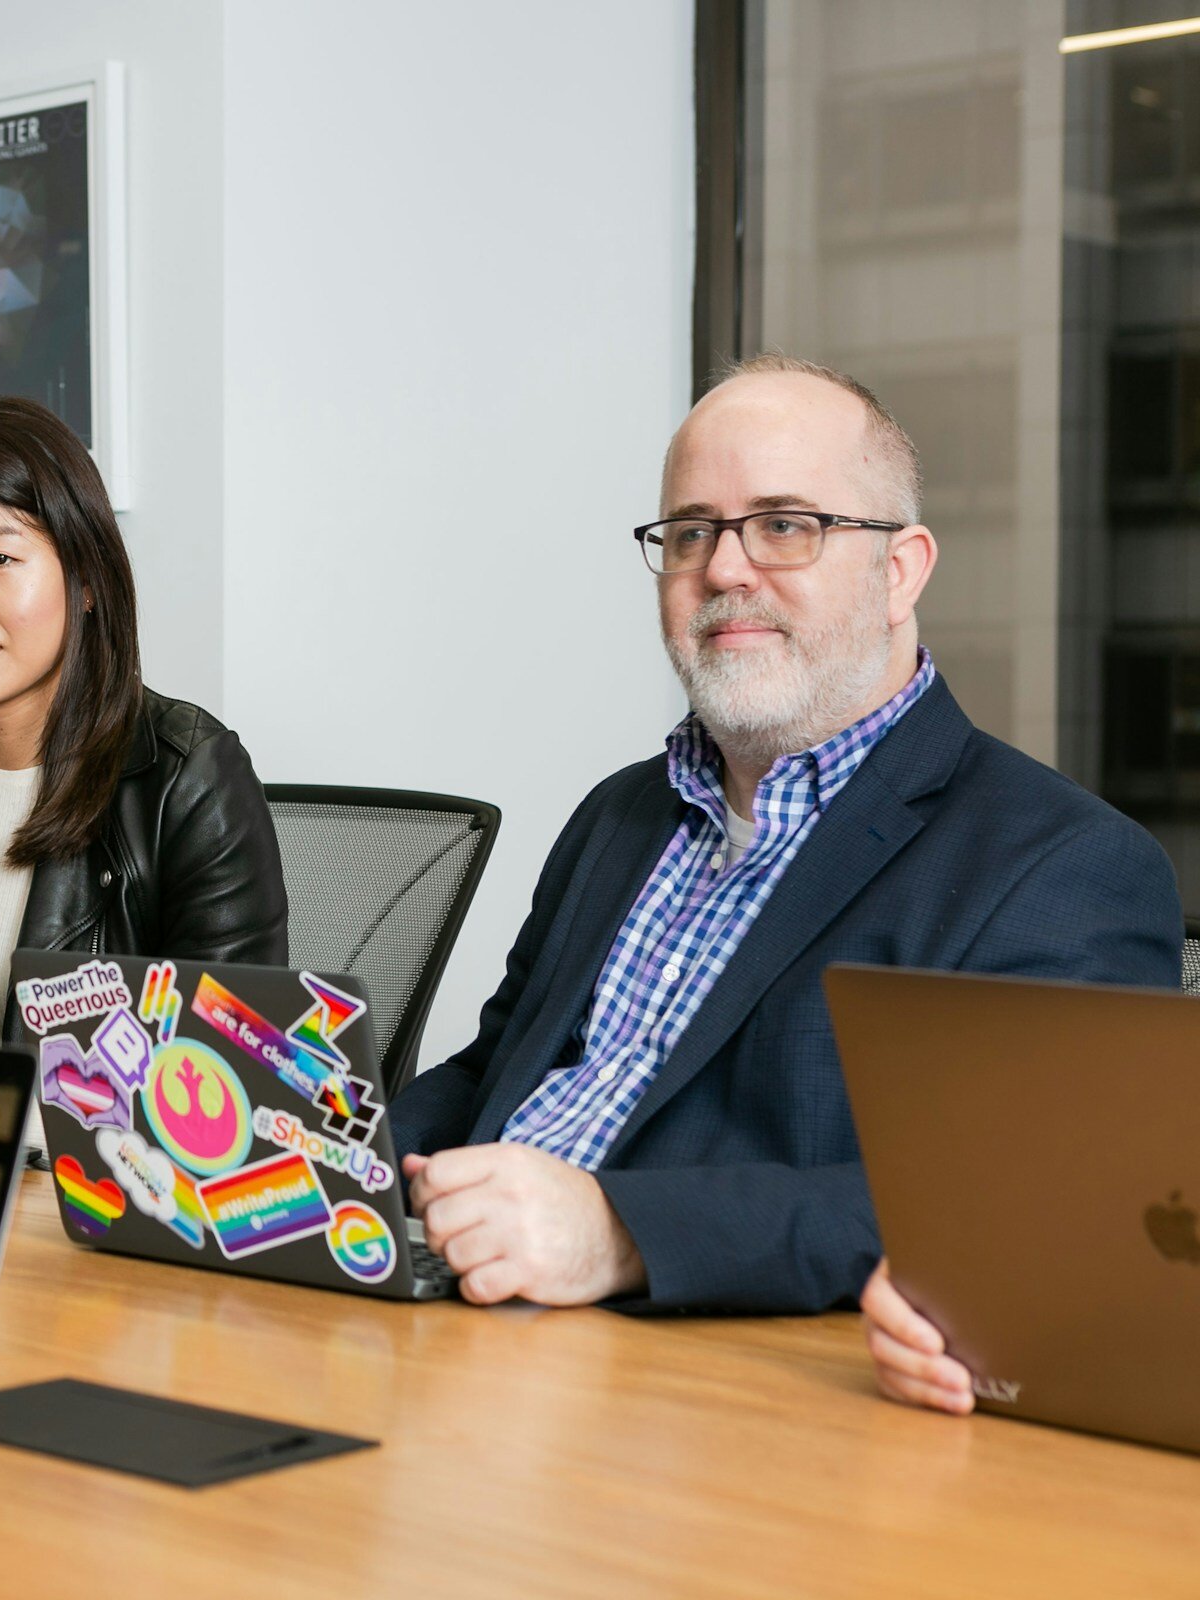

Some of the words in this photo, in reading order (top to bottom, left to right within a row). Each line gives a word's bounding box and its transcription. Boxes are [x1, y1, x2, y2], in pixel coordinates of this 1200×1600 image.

[26, 987, 127, 1029] Queerious
[211, 1005, 237, 1032] are
[238, 1022, 263, 1049] for
[259, 1113, 386, 1186] #ShowUp
[340, 1217, 386, 1266] G
[973, 1376, 1021, 1404] LLY
